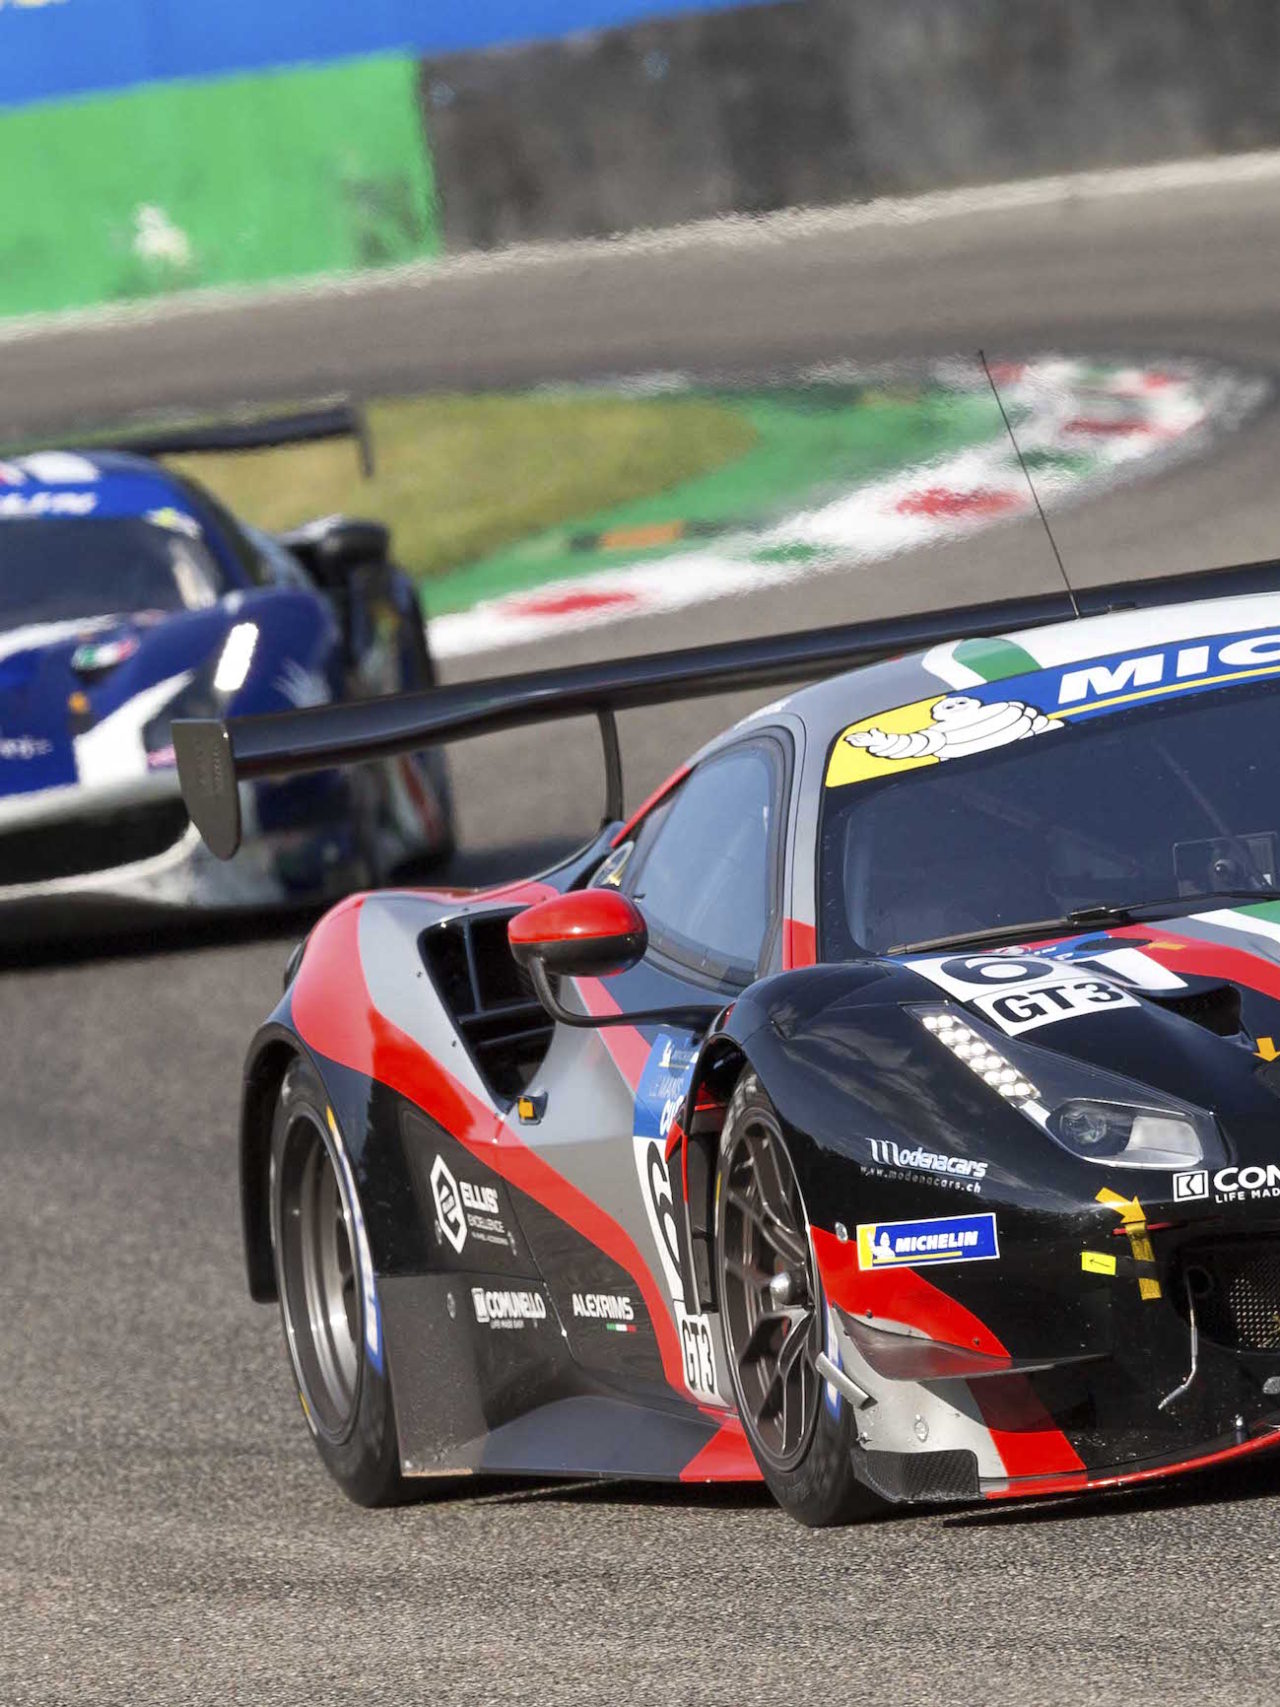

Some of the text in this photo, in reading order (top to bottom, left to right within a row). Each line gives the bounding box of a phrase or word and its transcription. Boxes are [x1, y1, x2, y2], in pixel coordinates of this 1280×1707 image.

[991, 982, 1125, 1024] GT3
[860, 1164, 982, 1194] www.modenacars.ch
[1215, 1190, 1245, 1204] LIFE
[895, 1231, 979, 1254] MICHELIN
[572, 1293, 635, 1321] ALEXRIMS
